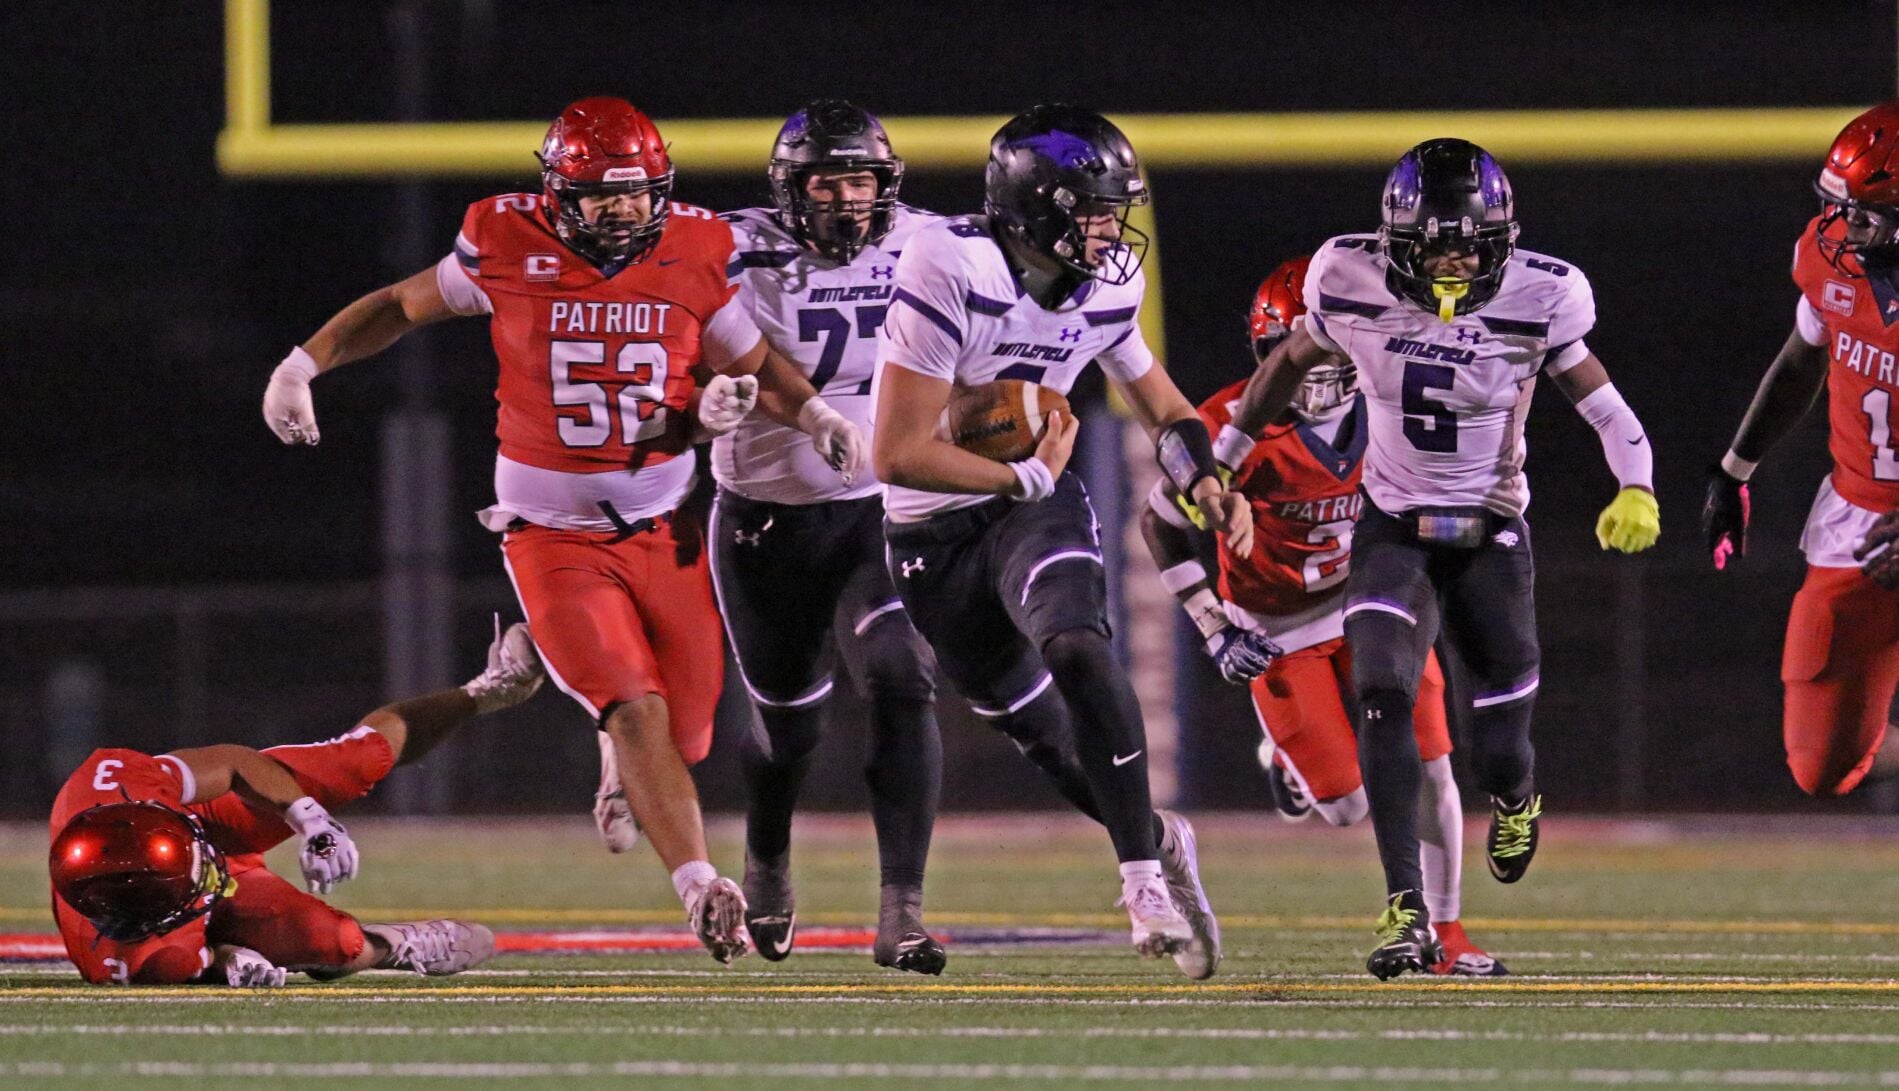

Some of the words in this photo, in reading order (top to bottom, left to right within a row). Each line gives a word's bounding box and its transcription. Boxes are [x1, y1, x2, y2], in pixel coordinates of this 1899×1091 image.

[527, 255, 560, 275] C
[550, 301, 672, 334] PATRIOT
[1823, 280, 1852, 308] C
[551, 341, 668, 447] 52
[1401, 360, 1458, 453] 5
[1862, 388, 1899, 479] 1
[1303, 519, 1355, 593] 2
[93, 759, 124, 791] 3
